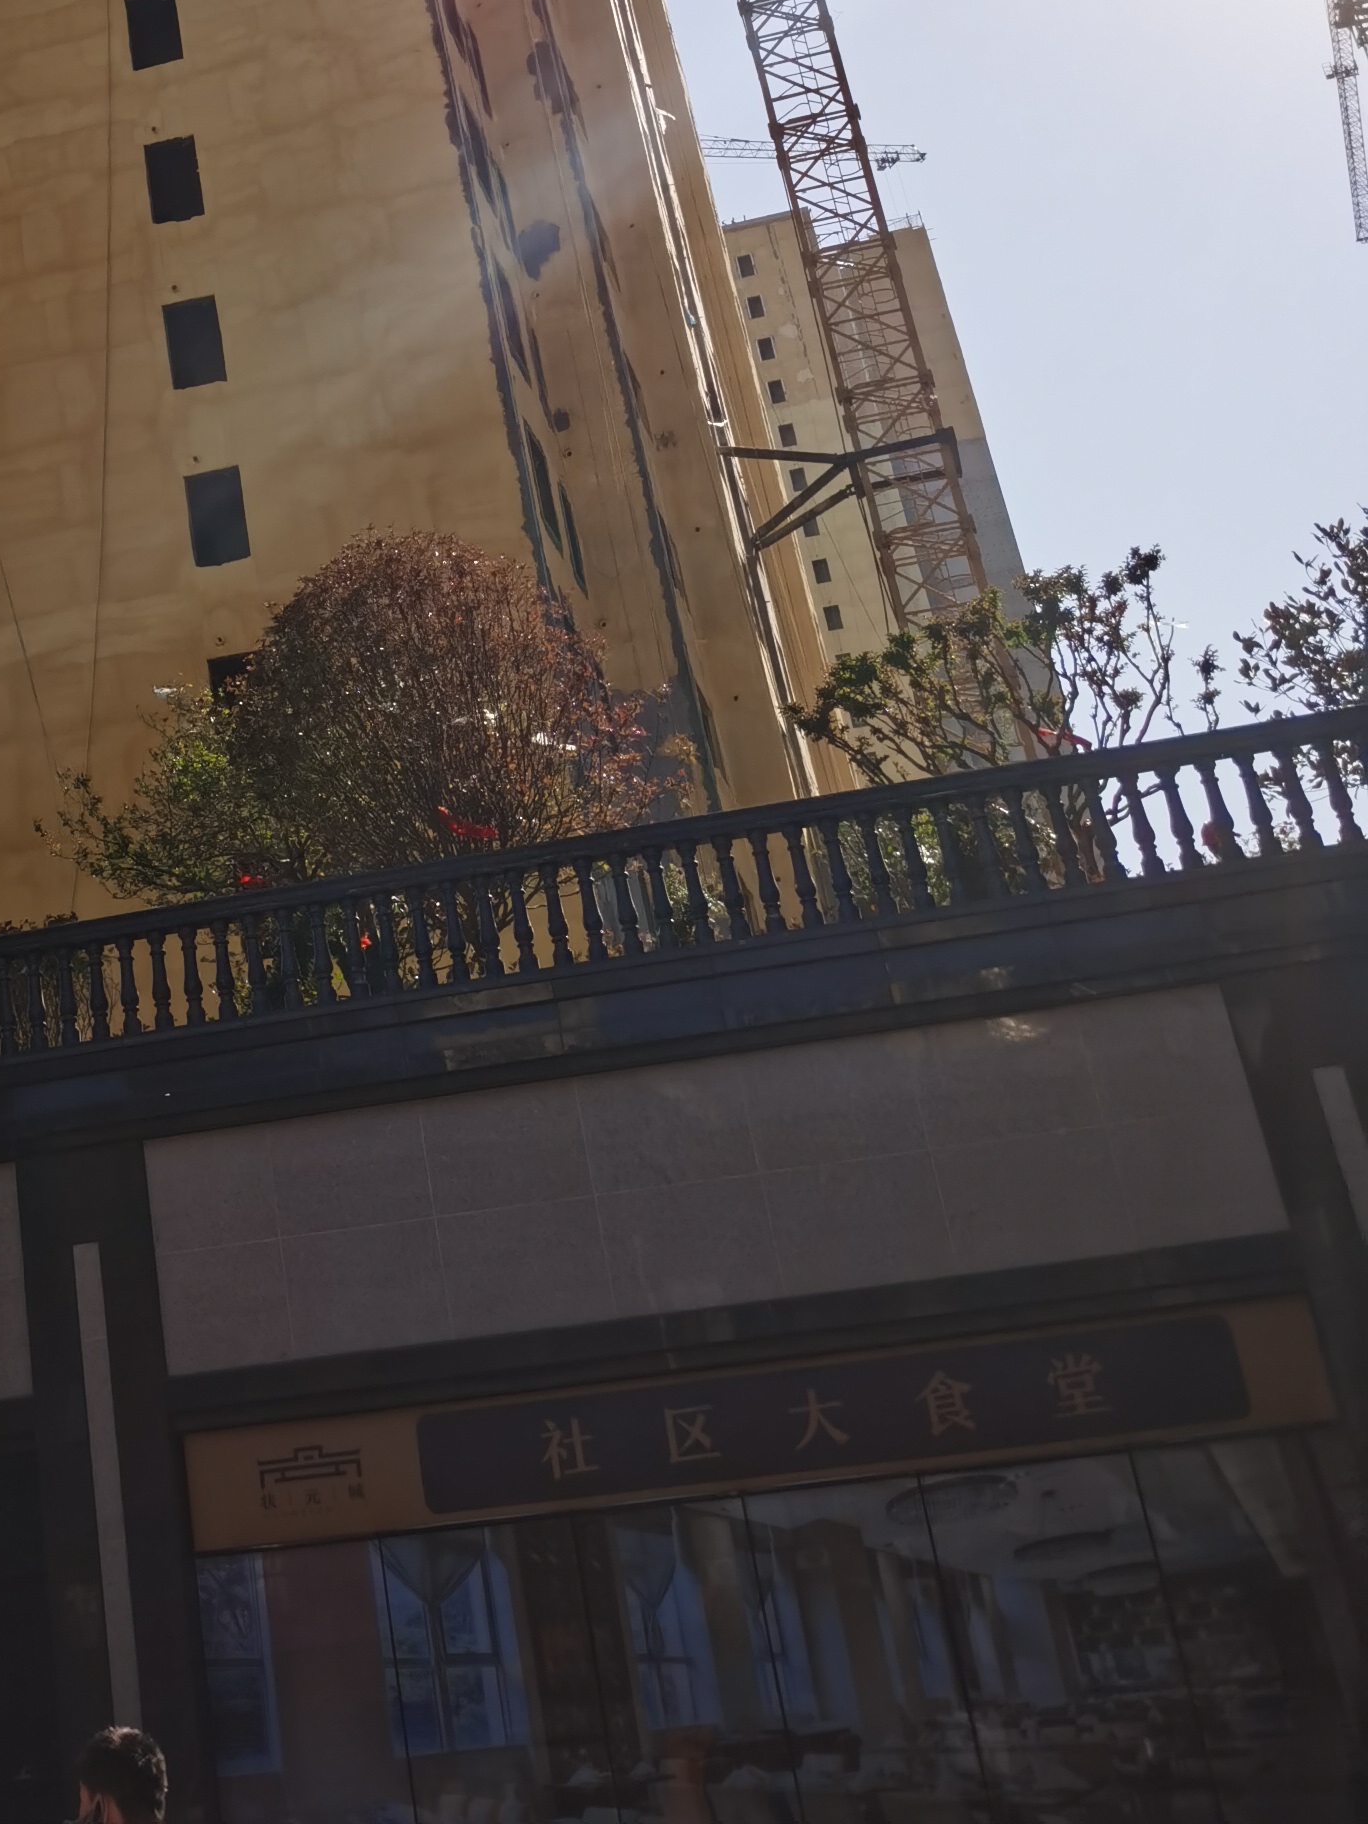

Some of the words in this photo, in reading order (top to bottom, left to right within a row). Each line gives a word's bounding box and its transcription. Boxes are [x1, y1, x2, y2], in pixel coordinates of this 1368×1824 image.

[540, 1353, 1113, 1481] 社区大食堂
